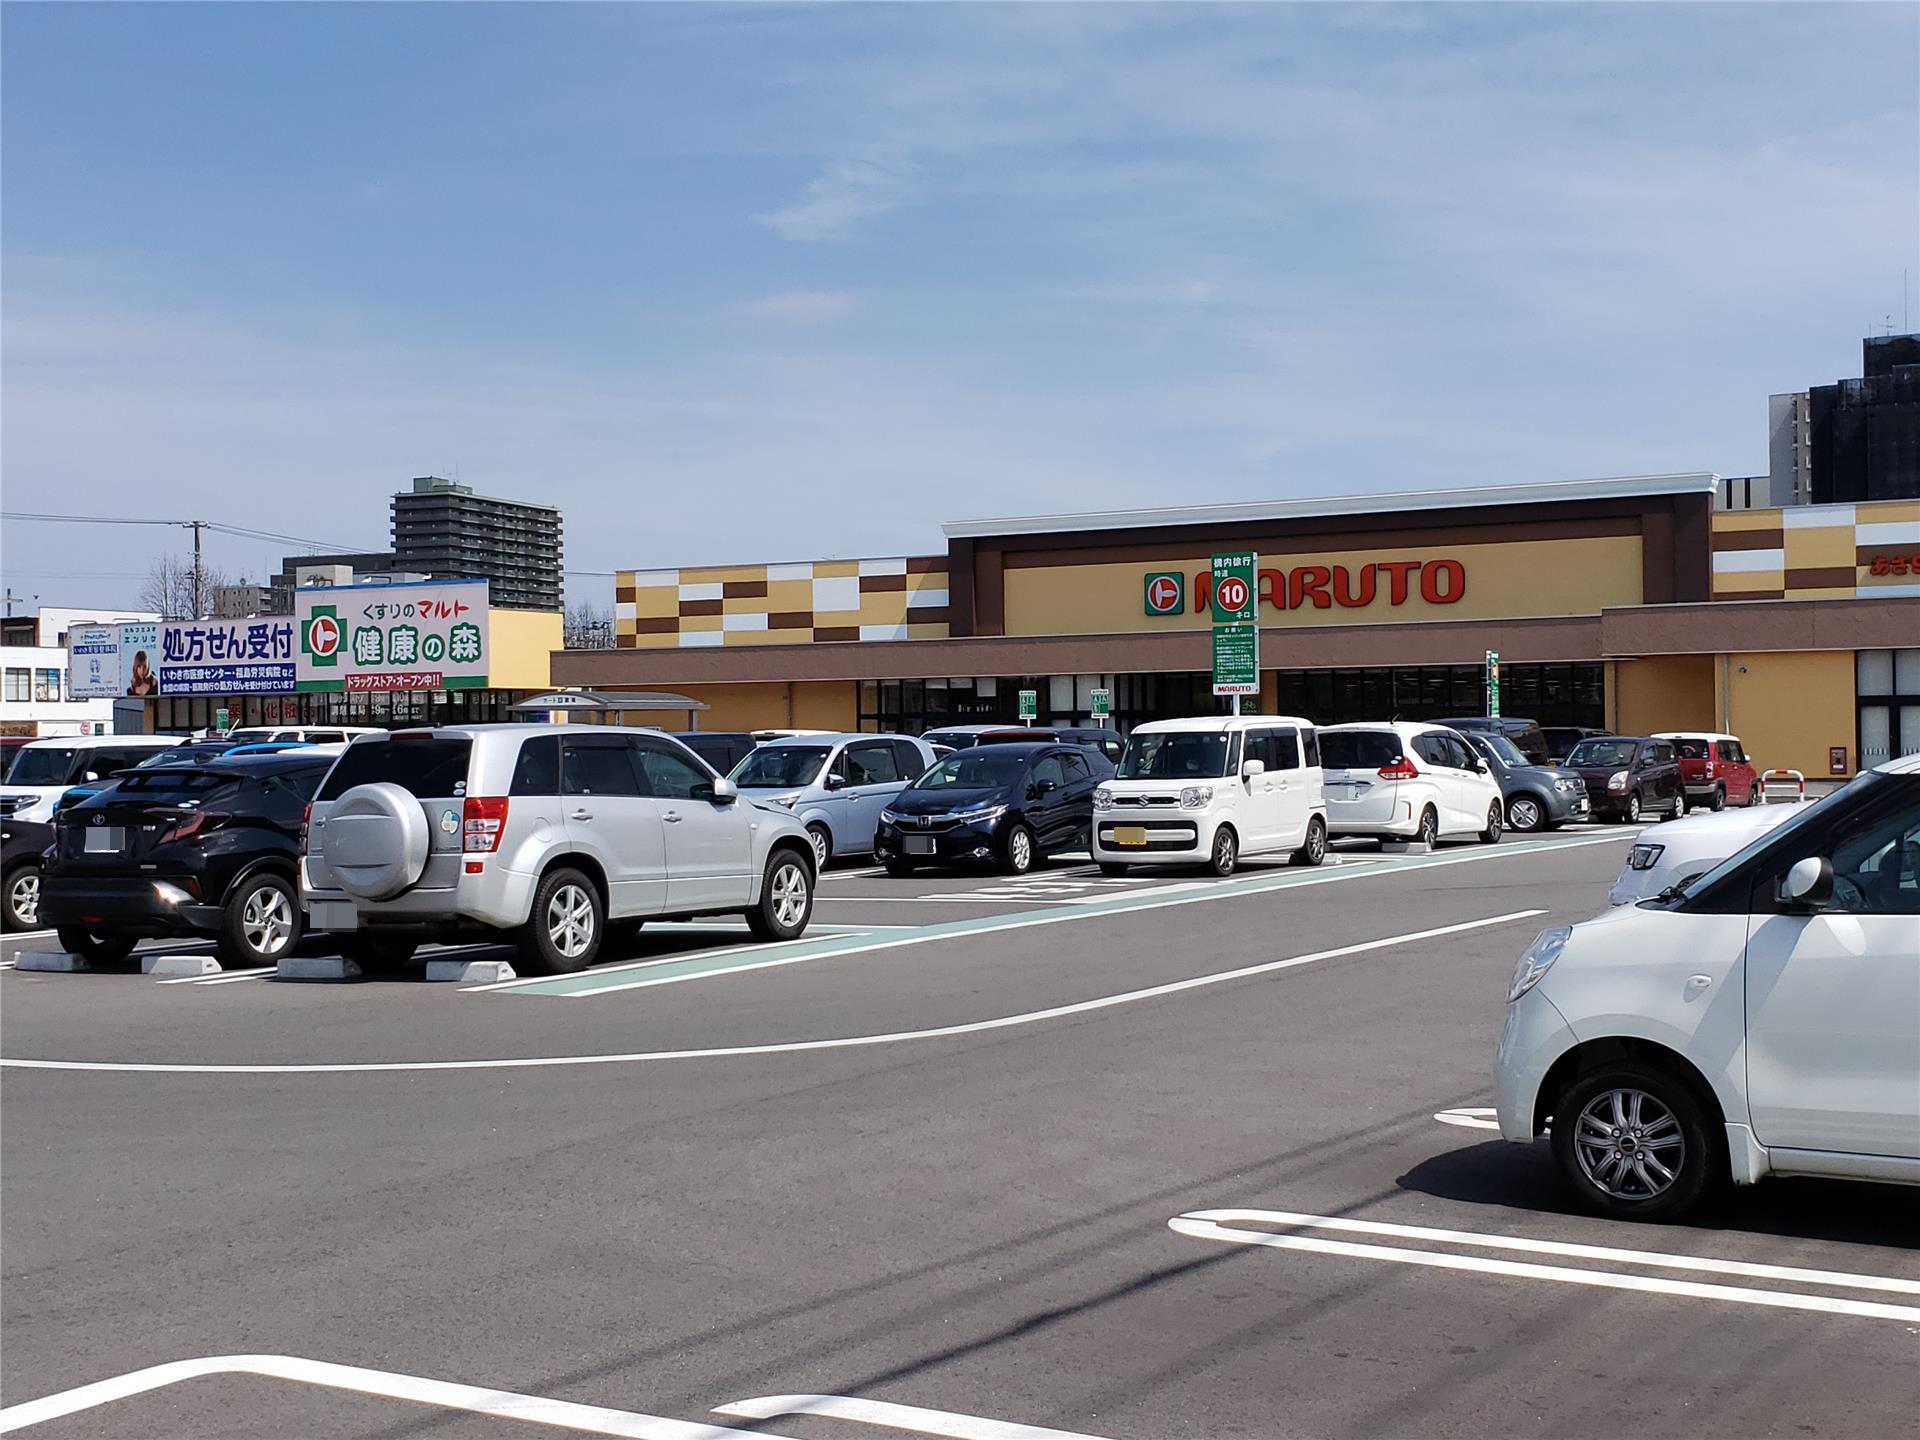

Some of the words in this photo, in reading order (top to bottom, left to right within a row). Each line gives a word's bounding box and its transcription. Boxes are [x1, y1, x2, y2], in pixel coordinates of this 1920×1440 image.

[1213, 556, 1251, 568] 構内徐行
[1222, 584, 1244, 604] 10
[362, 600, 470, 620] くすりのマルト
[1235, 610, 1251, 619] キロ
[162, 622, 294, 662] 処方せん受付
[354, 624, 480, 665] 健康の森
